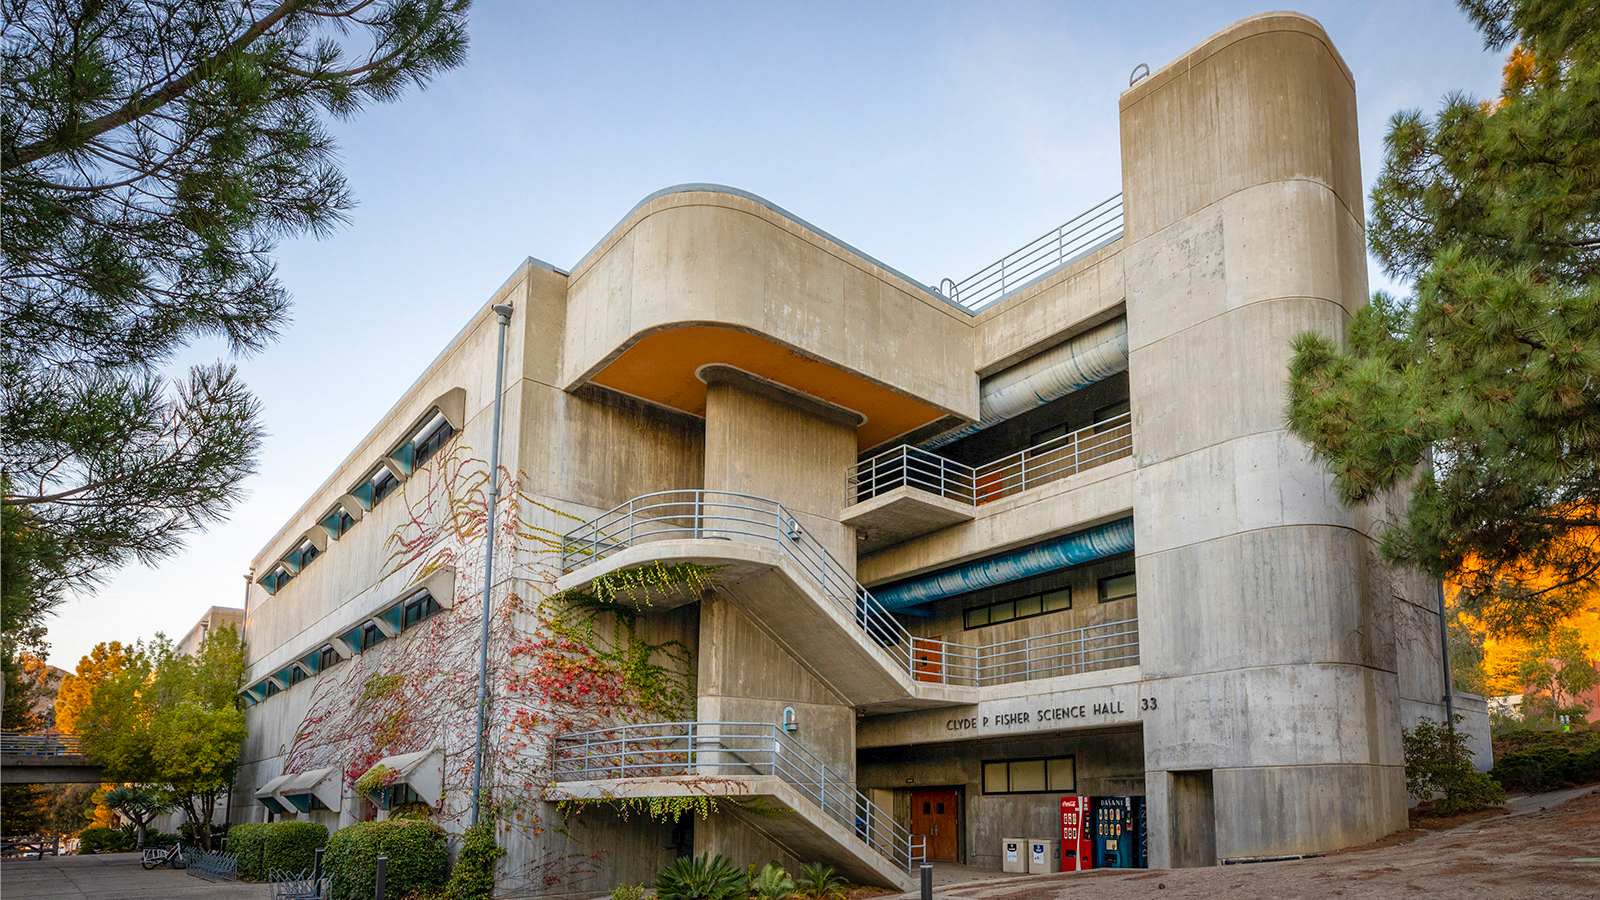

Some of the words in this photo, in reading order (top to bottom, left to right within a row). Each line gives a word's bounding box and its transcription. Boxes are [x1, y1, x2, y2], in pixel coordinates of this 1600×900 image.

[1141, 697, 1158, 711] 33
[946, 717, 977, 731] CLYDE
[995, 712, 1030, 726] FISHER
[1037, 705, 1086, 722] SCIENCE
[1093, 701, 1124, 716] HALL
